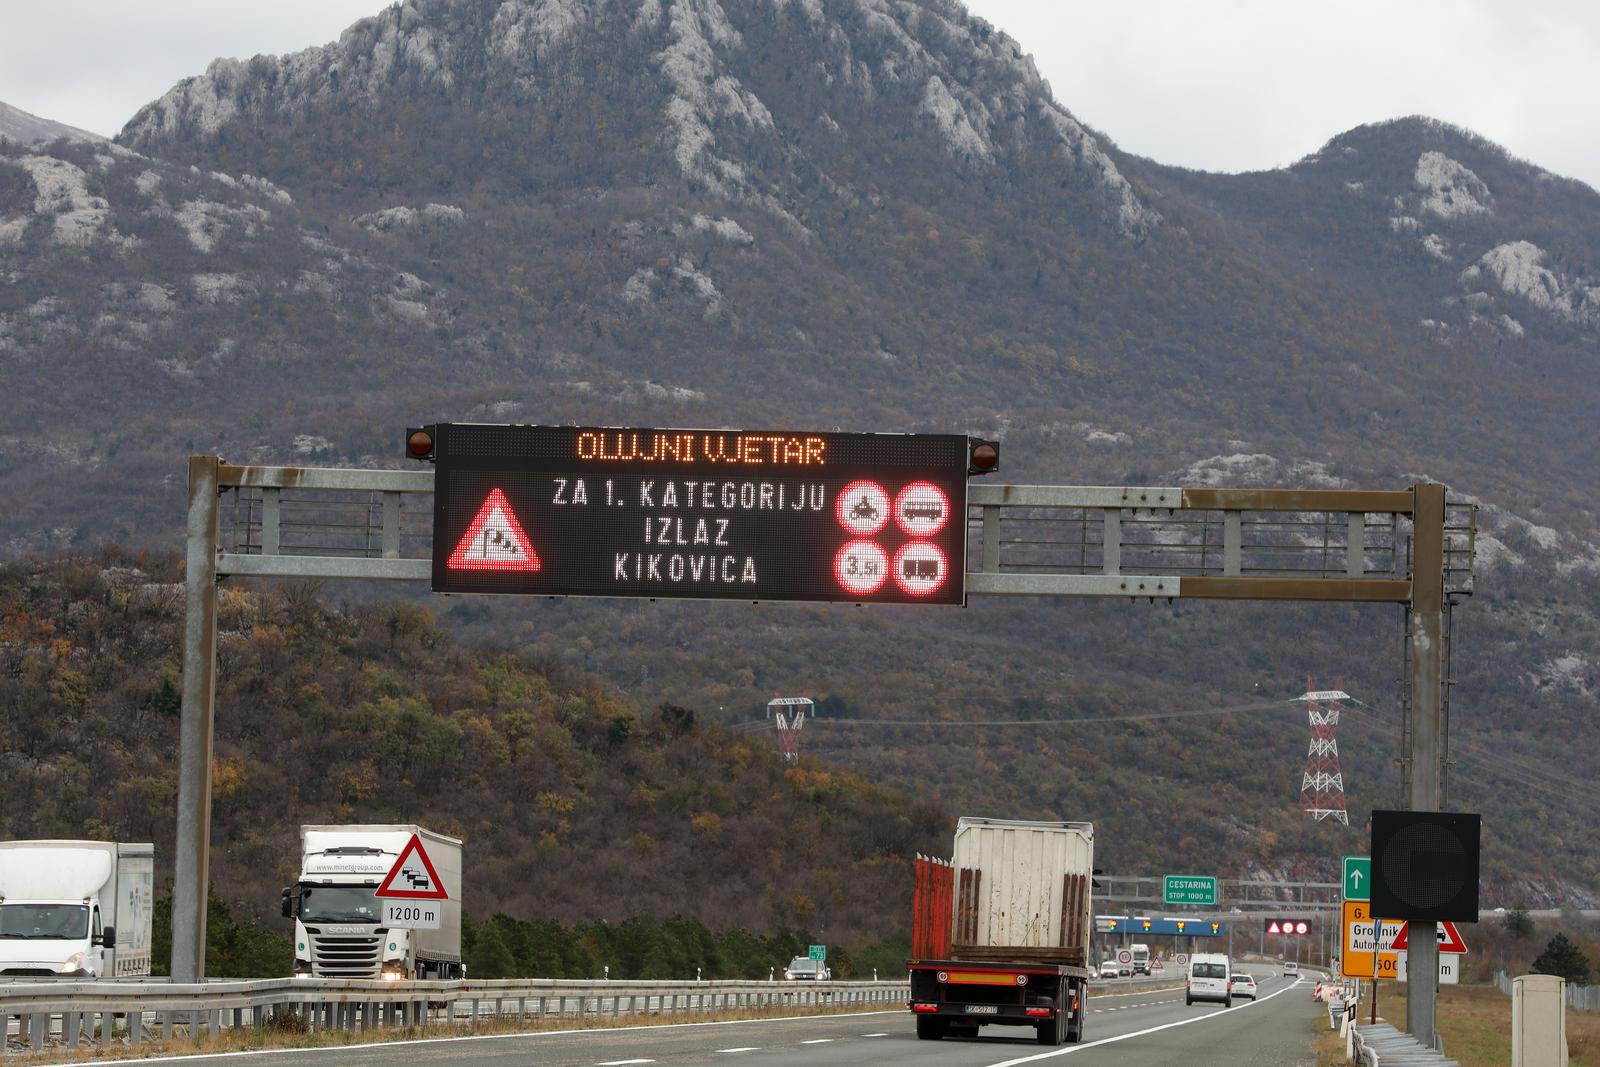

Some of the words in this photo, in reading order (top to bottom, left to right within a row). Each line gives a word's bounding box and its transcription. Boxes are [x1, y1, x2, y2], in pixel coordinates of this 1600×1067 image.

[578, 433, 694, 462] OLUJNI
[704, 435, 825, 465] VJETAR
[552, 477, 588, 505] ZA
[606, 478, 624, 506] 1.
[639, 480, 825, 511] KATEGORIJU
[645, 517, 729, 546] IZLAZ
[615, 552, 757, 583] KIKOVICA
[1169, 881, 1212, 889] CESTARINA
[390, 907, 420, 921] 1200
[424, 911, 435, 921] m
[1354, 908, 1365, 919] G.
[1354, 924, 1399, 936] Gronik
[1441, 965, 1451, 975] m
